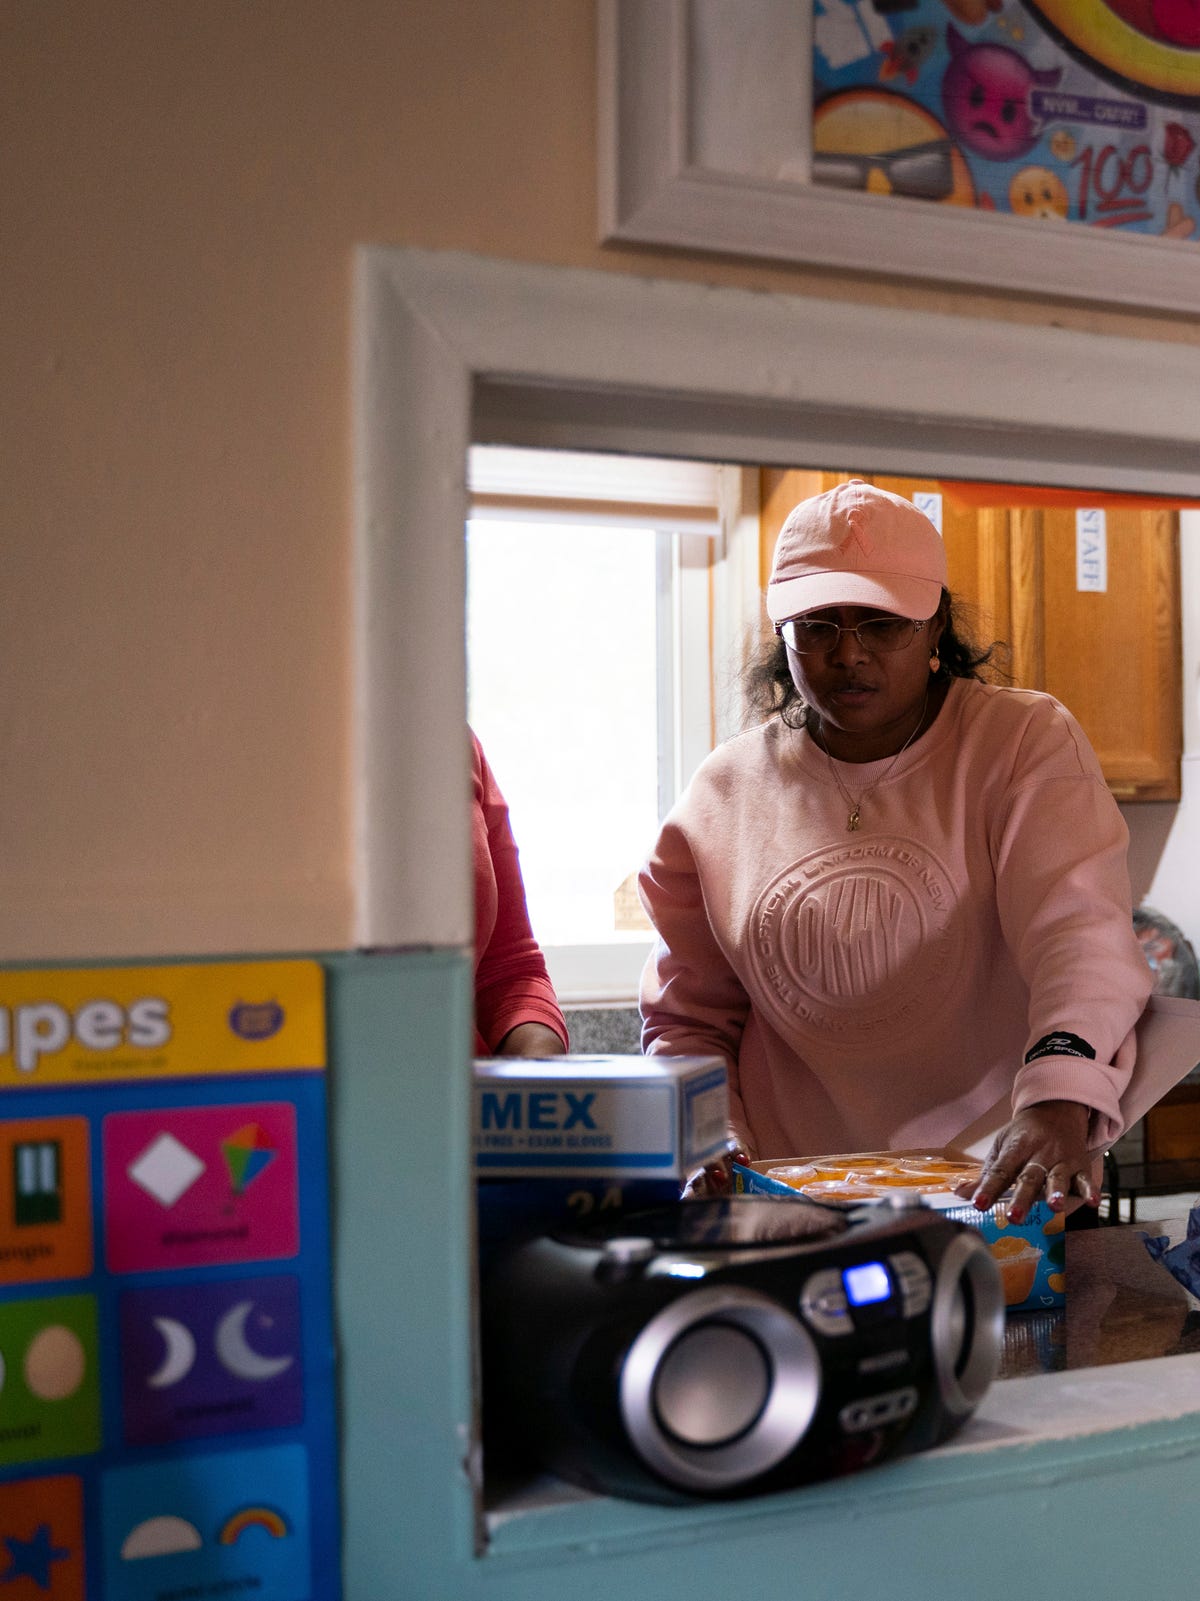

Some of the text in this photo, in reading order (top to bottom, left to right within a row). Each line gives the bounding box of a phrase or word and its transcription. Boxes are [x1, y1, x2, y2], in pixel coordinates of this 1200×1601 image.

[1072, 142, 1155, 220] 100
[1082, 509, 1101, 588] STAFF
[917, 866, 949, 914] NEW
[0, 997, 173, 1073] pes
[481, 1092, 597, 1130] MEX
[528, 1135, 562, 1147] EXAM
[566, 1135, 612, 1147] GLOVES
